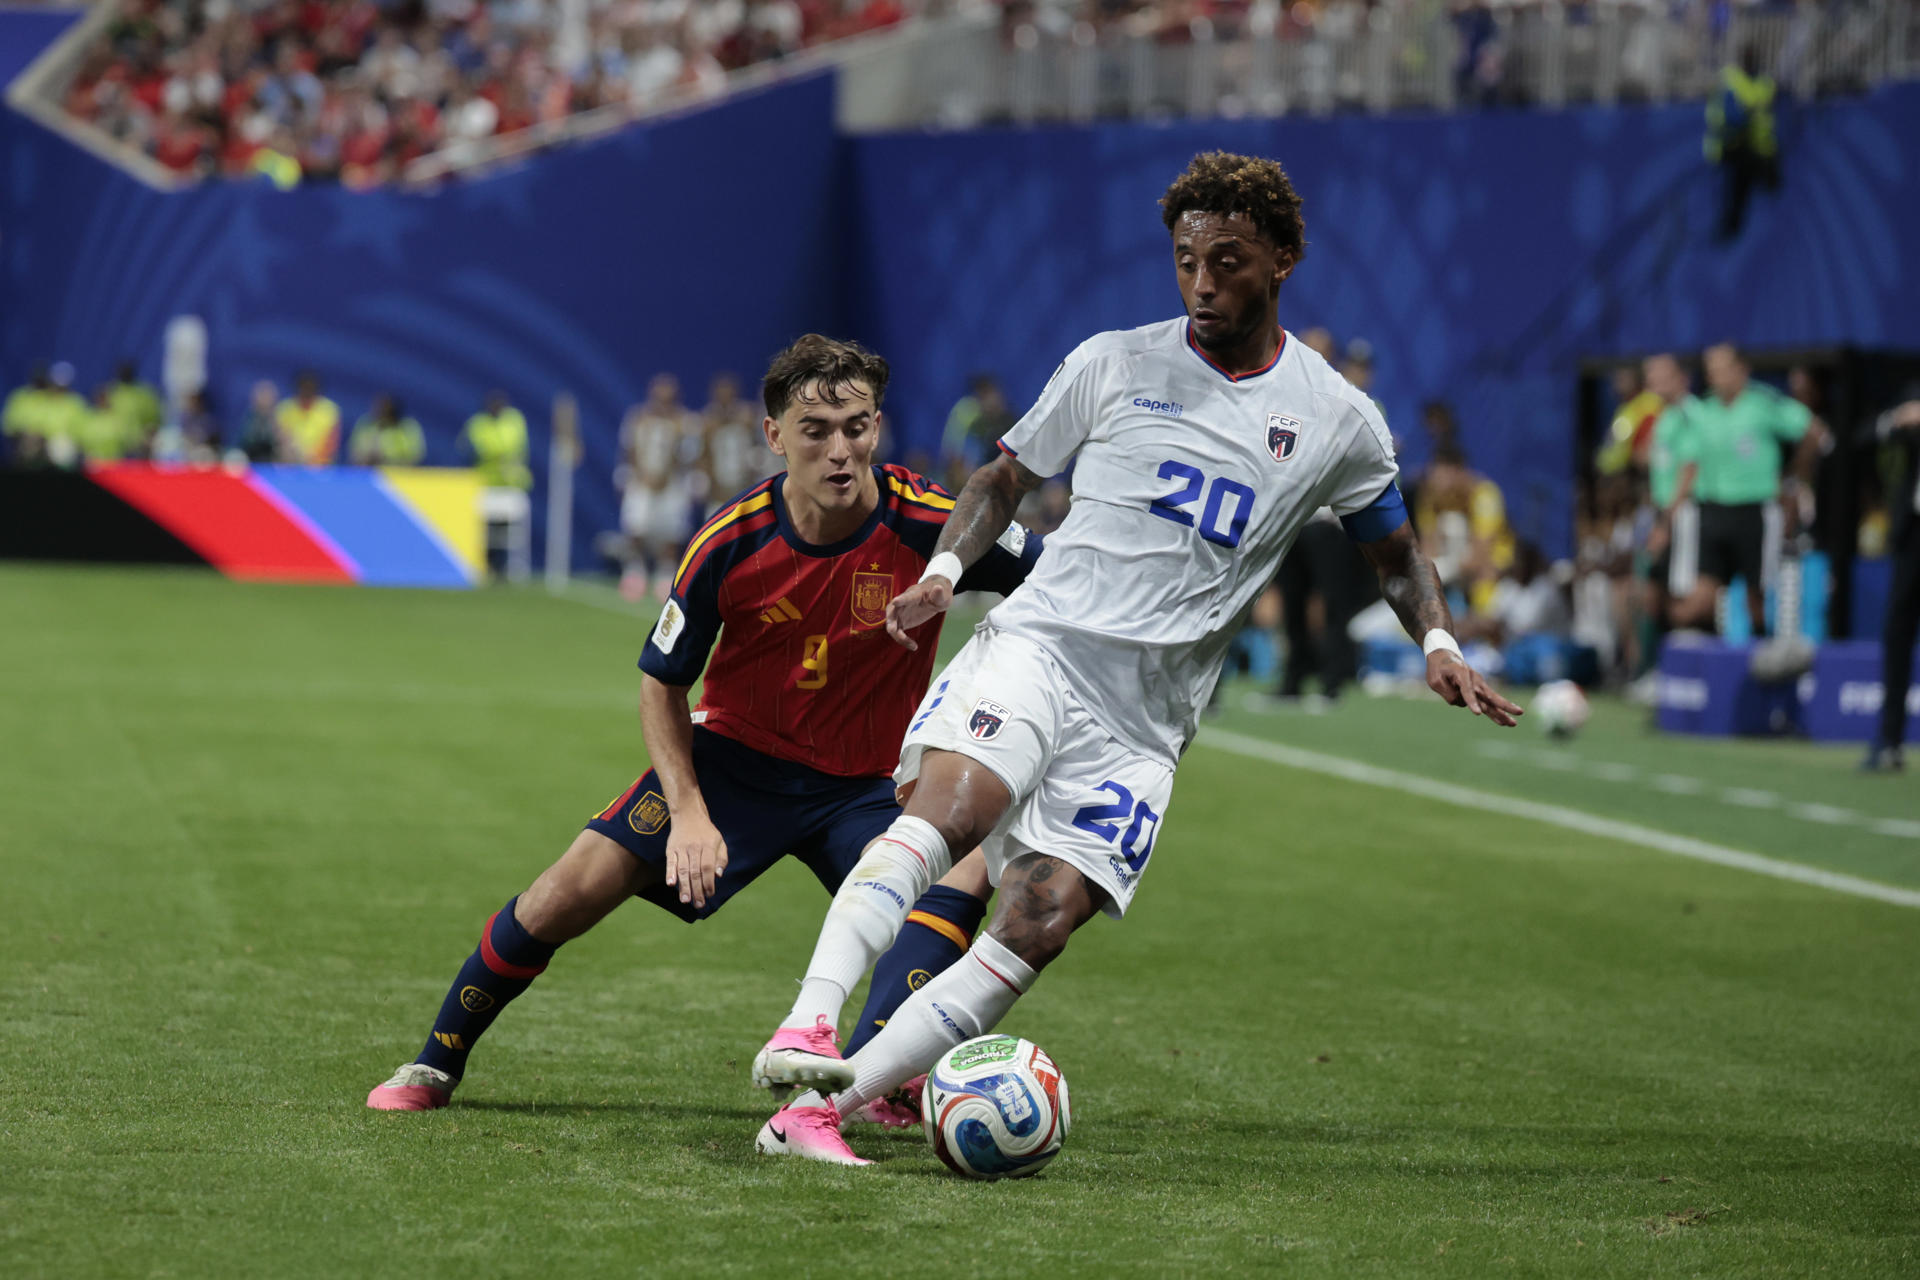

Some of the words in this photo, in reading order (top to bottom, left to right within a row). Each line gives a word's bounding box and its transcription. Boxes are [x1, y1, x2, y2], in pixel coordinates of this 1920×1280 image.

[1133, 397, 1183, 414] capelli
[1270, 415, 1299, 427] FCF
[1148, 459, 1256, 549] 20
[796, 634, 828, 689] 9
[980, 700, 1009, 714] FCF
[1071, 780, 1159, 872] 20
[960, 1050, 1007, 1066] TRIONDA
